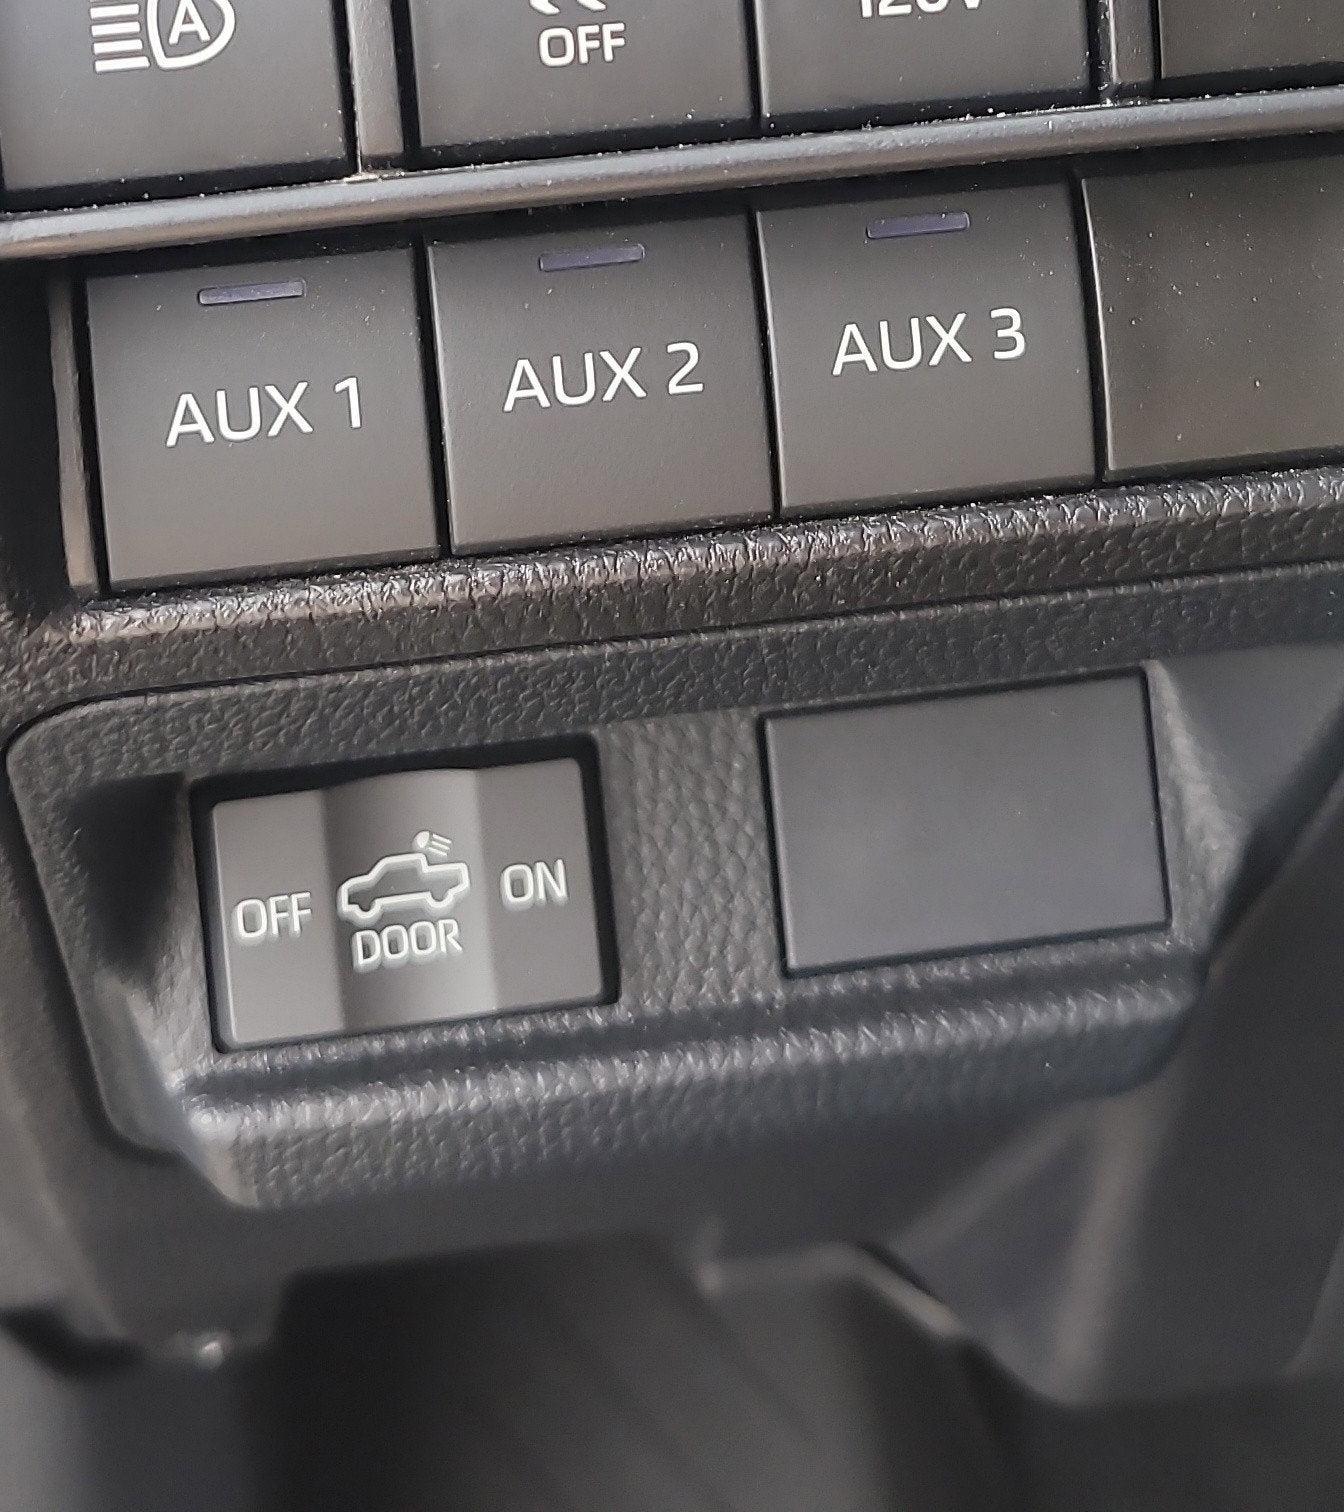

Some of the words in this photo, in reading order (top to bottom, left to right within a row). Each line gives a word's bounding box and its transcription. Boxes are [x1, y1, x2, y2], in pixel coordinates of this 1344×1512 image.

[539, 22, 626, 68] OFF
[831, 311, 973, 376] AUX
[989, 306, 1026, 361] 3
[503, 346, 648, 412] AUX
[666, 341, 705, 396] 2
[165, 380, 314, 448] AUX
[334, 377, 363, 429] 1
[501, 859, 569, 910] ON
[233, 891, 312, 945] OFF
[352, 918, 463, 972] DOOR
